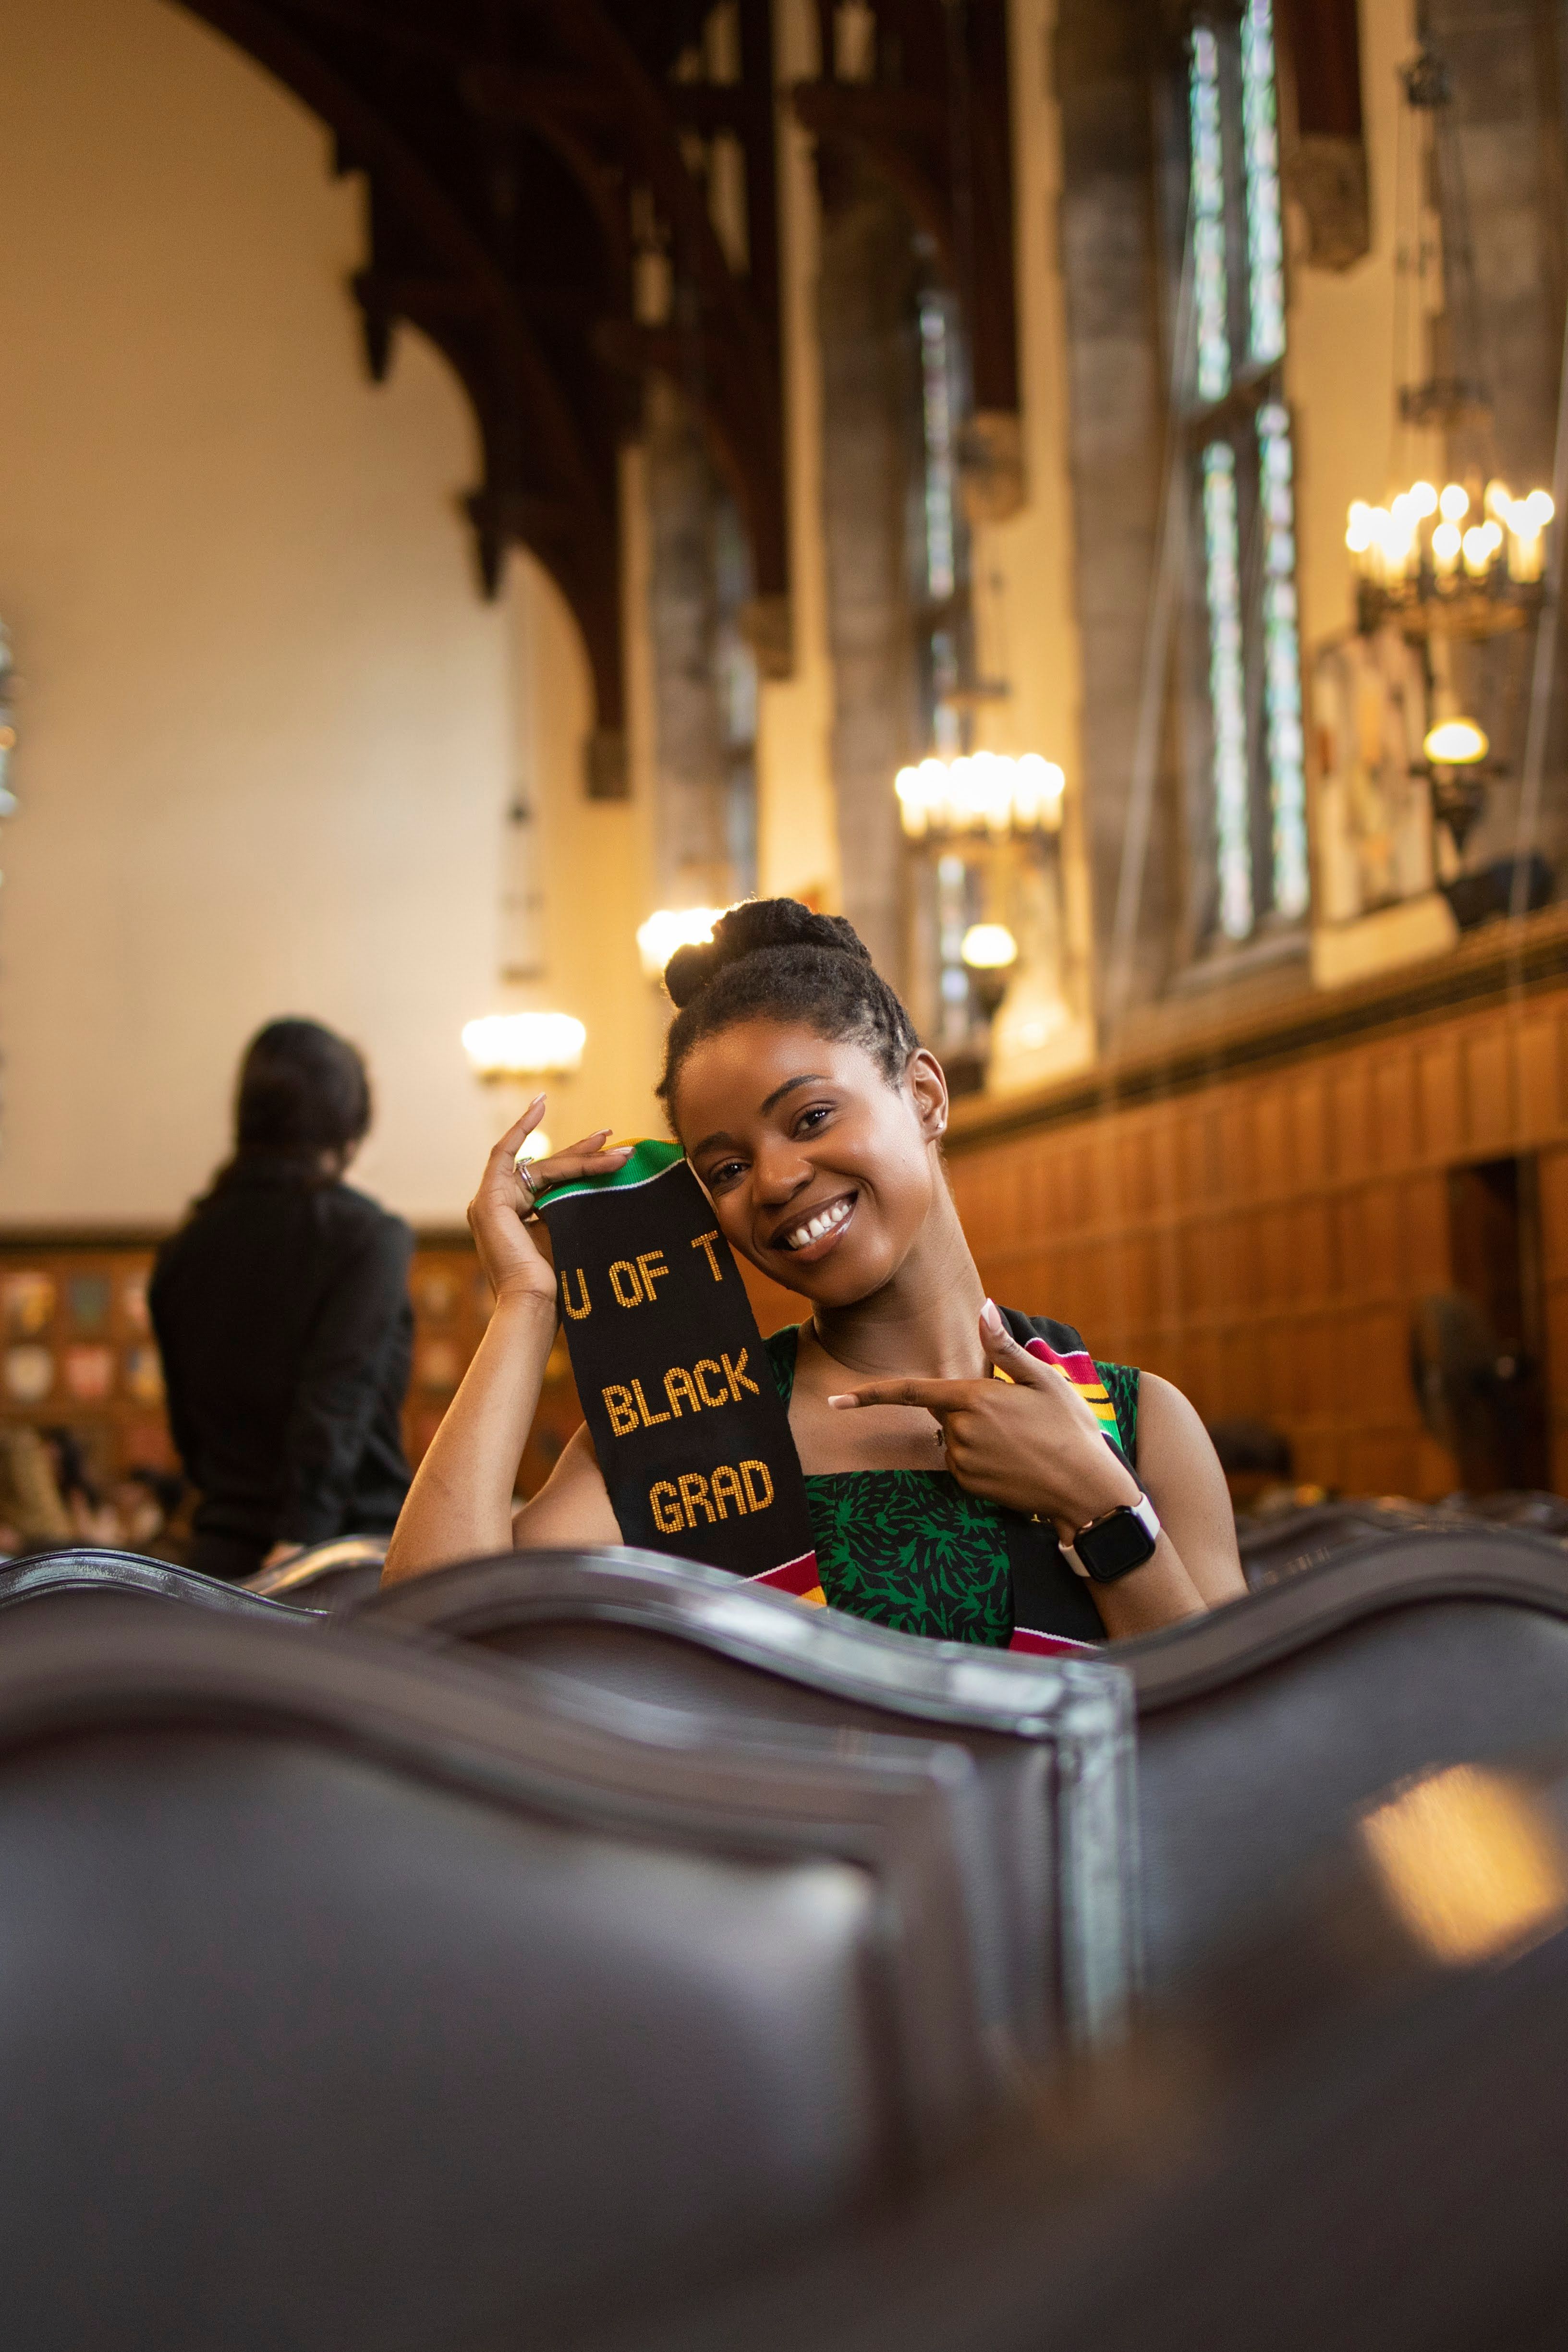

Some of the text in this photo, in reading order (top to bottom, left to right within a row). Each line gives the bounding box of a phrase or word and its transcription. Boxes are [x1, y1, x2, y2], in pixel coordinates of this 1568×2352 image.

[561, 1230, 719, 1319] U OF T
[602, 1348, 759, 1436] BLACK
[650, 1460, 774, 1533] GRAD
